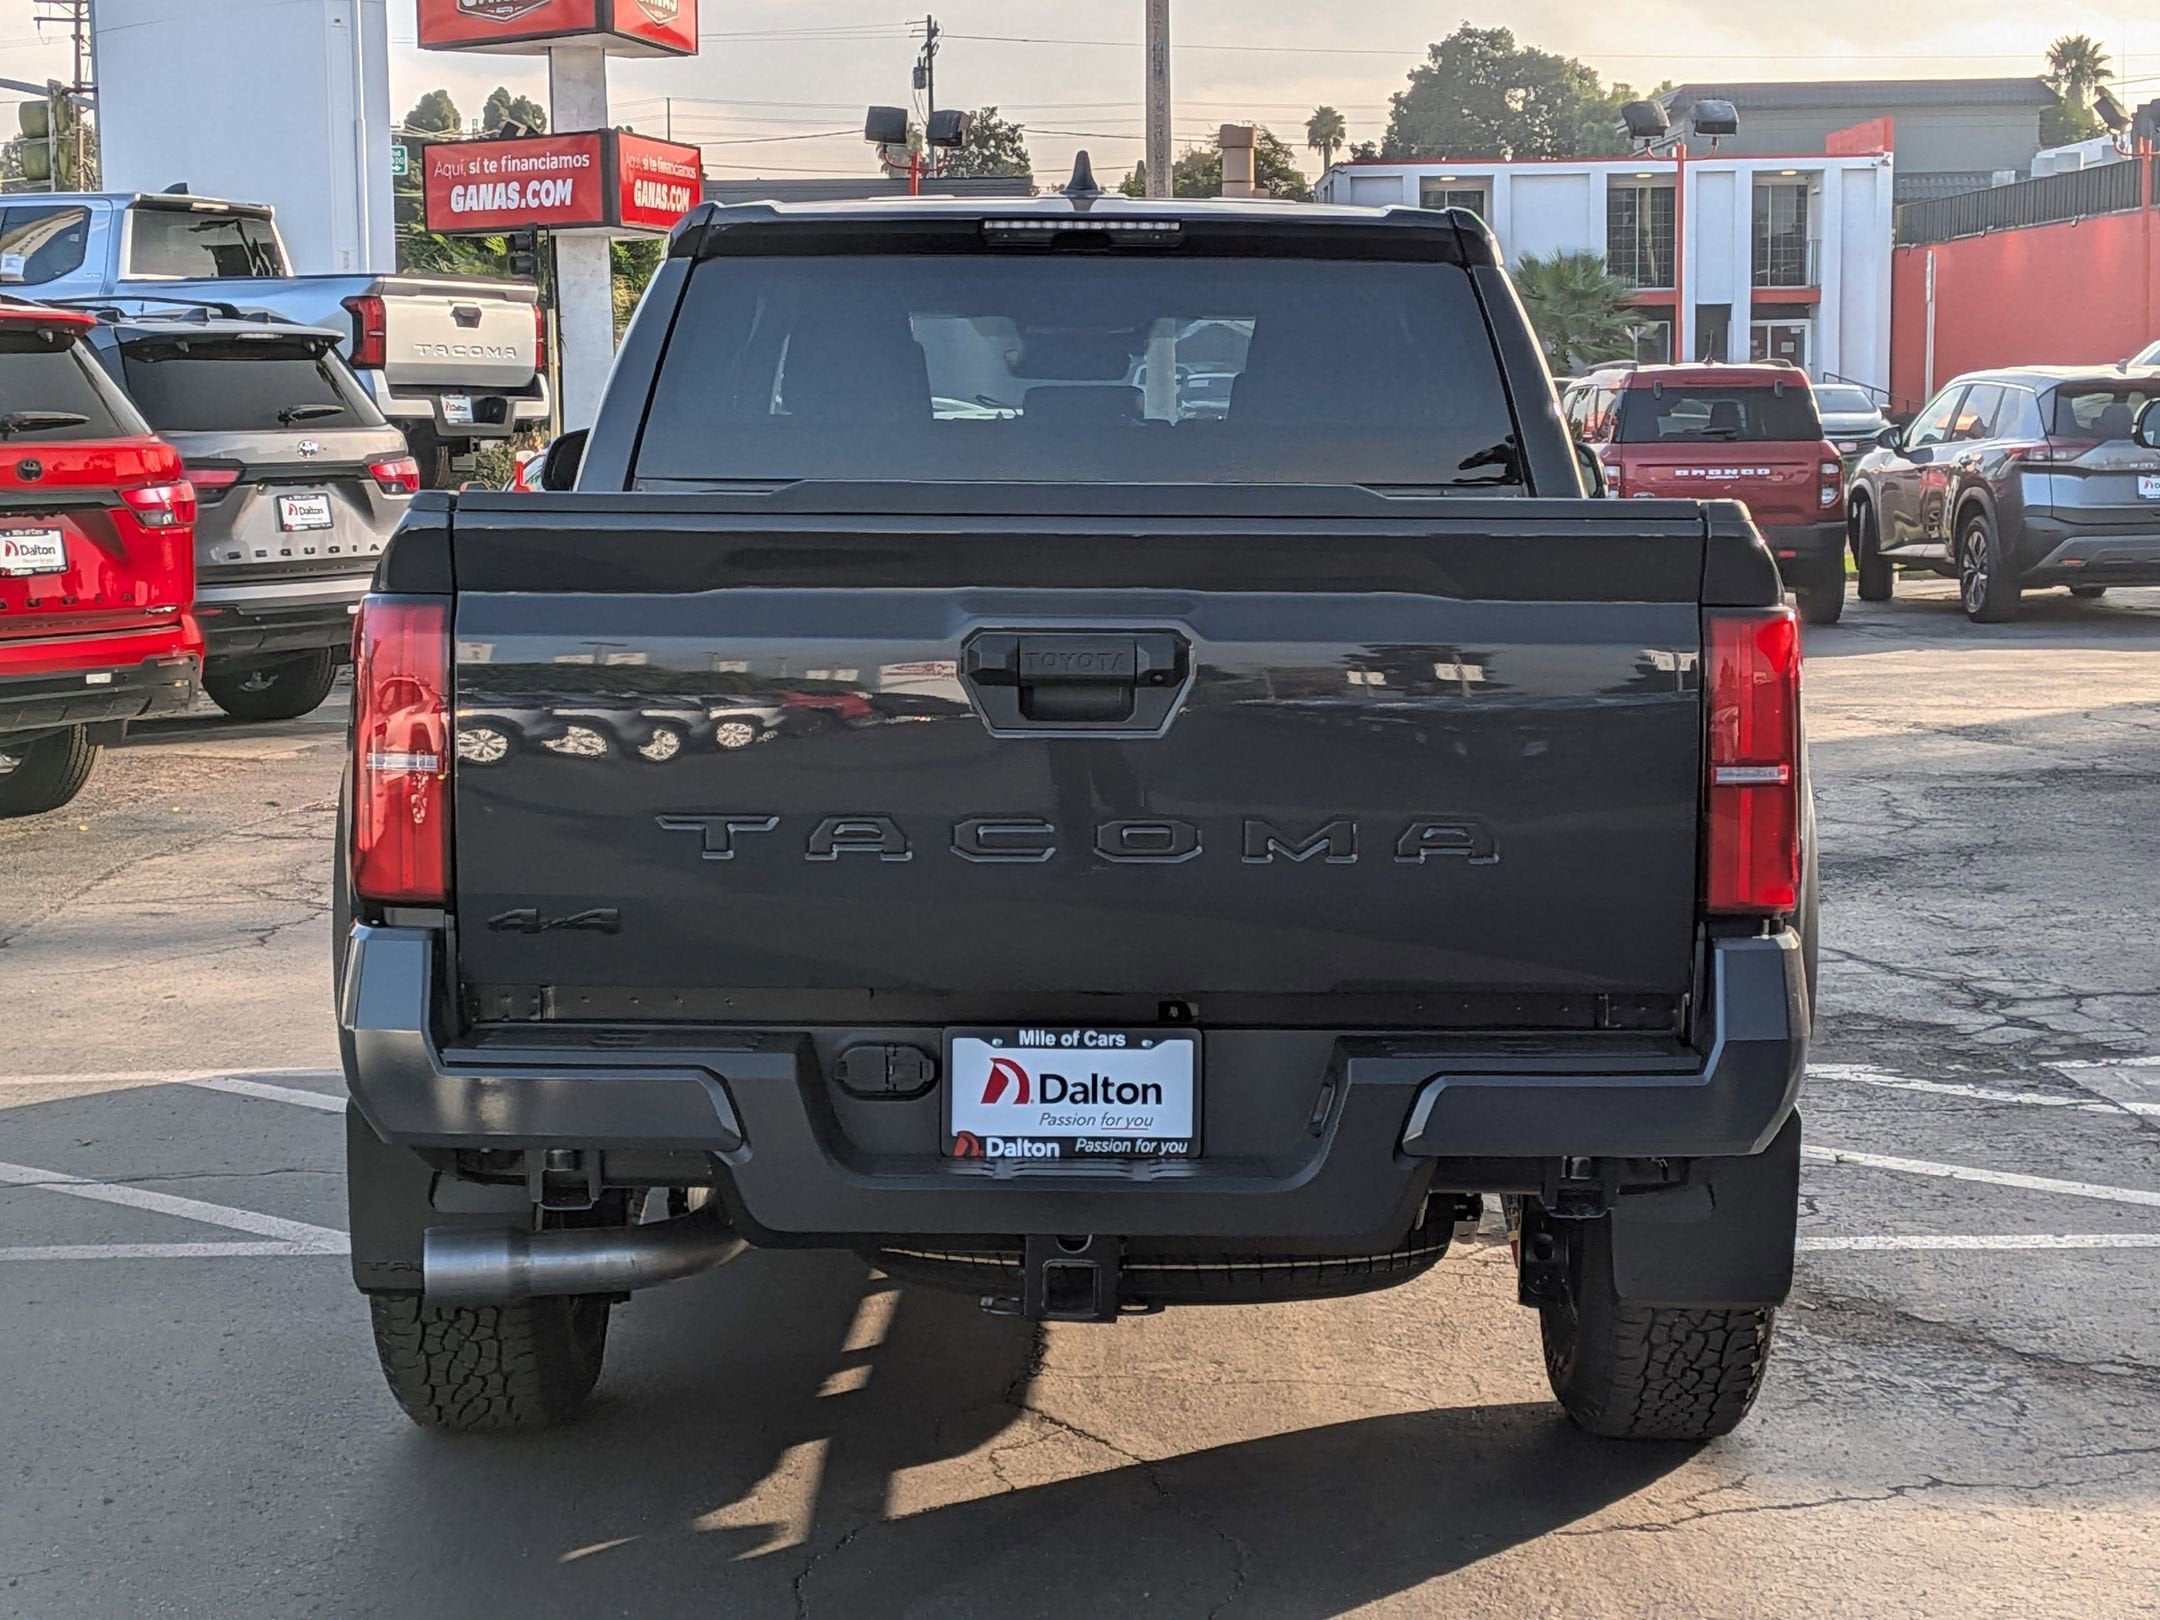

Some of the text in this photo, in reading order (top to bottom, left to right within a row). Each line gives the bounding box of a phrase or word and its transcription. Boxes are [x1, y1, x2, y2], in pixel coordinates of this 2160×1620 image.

[469, 158, 480, 174] sí
[483, 158, 497, 173] te
[501, 152, 590, 172] financiamos
[450, 178, 573, 212] GANAS.COM
[634, 179, 690, 213] GANAS.COM
[414, 344, 517, 358] TACOMA
[1674, 468, 1771, 476] BRONCO
[20, 544, 56, 556] Dalton
[228, 543, 380, 560] SEQUOIA
[1024, 652, 1129, 672] TOYOTA
[655, 814, 1499, 864] TACOMA
[1019, 1029, 1126, 1047] Mile of Cars
[1039, 1073, 1162, 1105] Dalton
[1039, 1112, 1154, 1128] Passion for you
[986, 1138, 1060, 1158] Dalton
[1075, 1137, 1188, 1155] Passion for you
